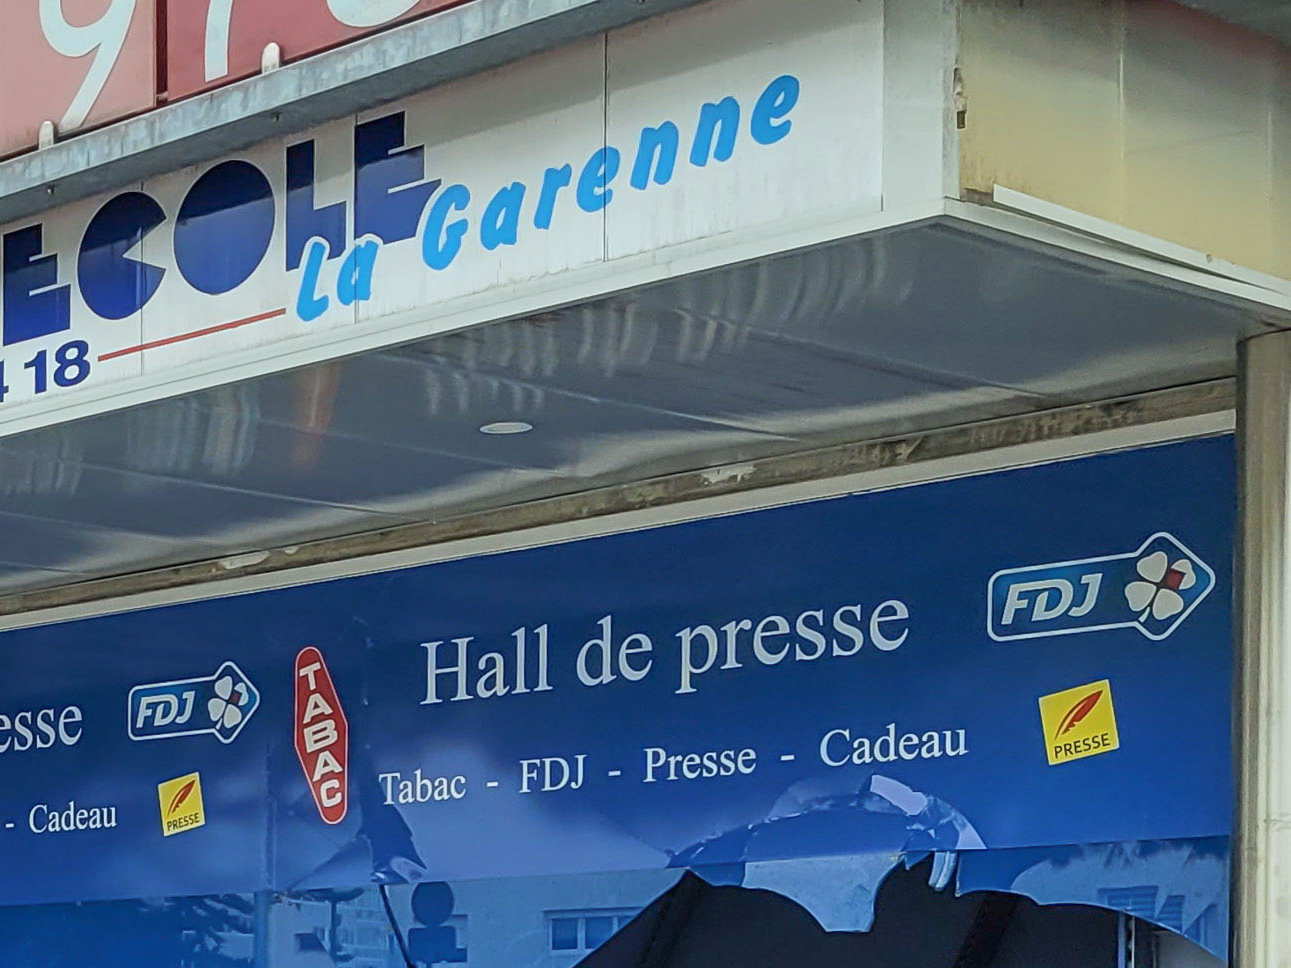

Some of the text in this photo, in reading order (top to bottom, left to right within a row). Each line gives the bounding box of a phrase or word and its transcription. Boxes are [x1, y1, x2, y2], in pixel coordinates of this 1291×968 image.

[295, 75, 801, 322] La Garenne
[2, 110, 442, 346] ECOLE
[23, 340, 92, 394] 18
[1000, 571, 1104, 627] FDJ
[419, 597, 912, 707] Hall de presse
[135, 690, 197, 730] FDJ
[298, 661, 343, 809] TABAC
[377, 769, 468, 807] Tabac
[519, 753, 587, 796] FDJ
[642, 745, 758, 784] Presse
[820, 724, 969, 770] Cadeau
[1053, 737, 1111, 761] PRESSE
[28, 802, 118, 834] Cadeau
[166, 811, 201, 833] PRESSE
